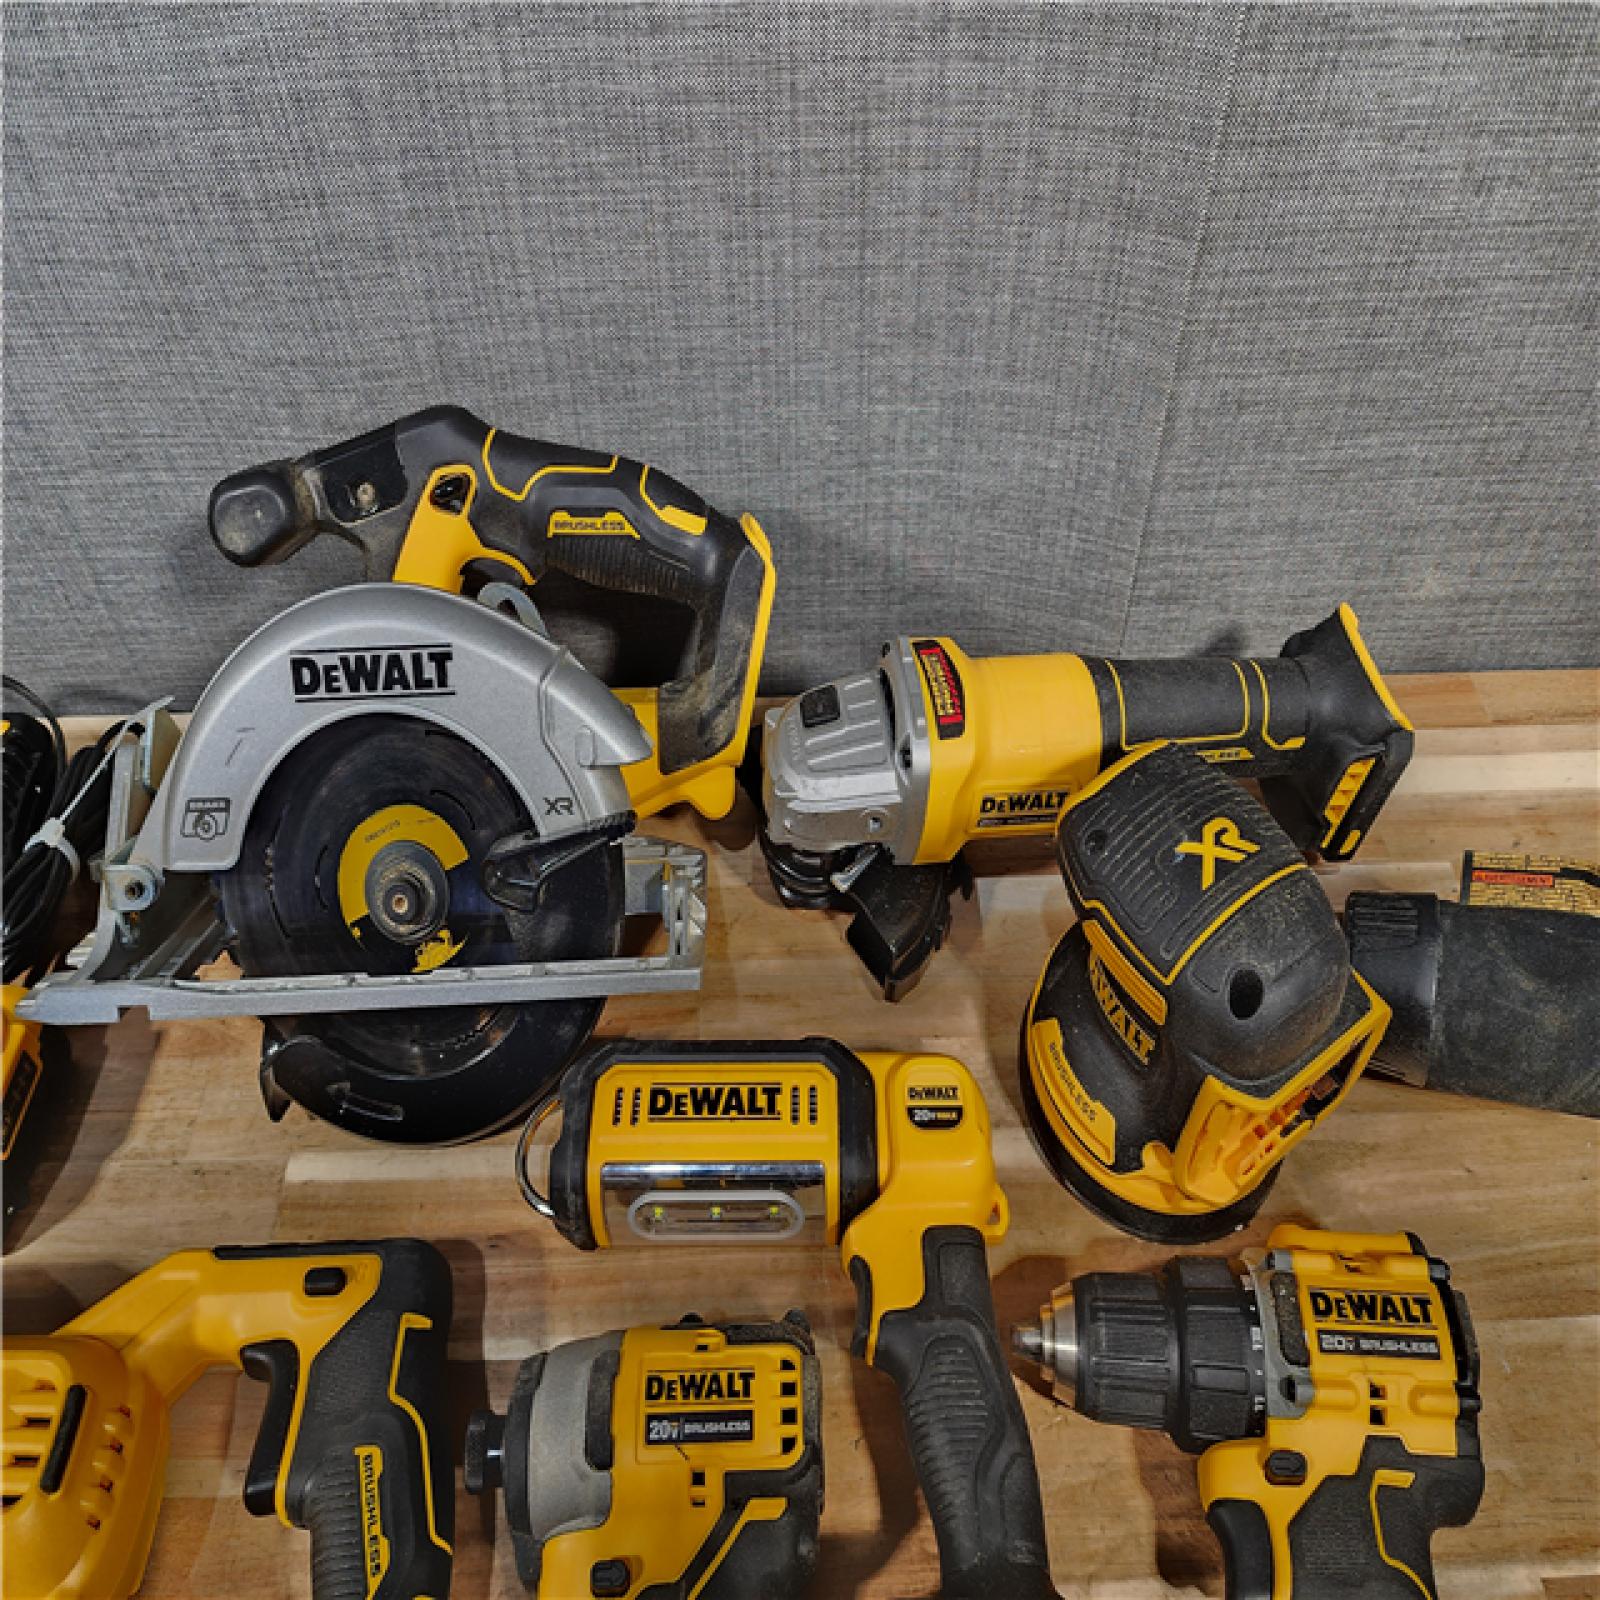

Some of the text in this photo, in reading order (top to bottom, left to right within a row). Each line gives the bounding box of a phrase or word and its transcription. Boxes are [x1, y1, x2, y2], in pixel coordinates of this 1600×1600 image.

[554, 521, 625, 531] BRUSHLESS
[290, 652, 453, 696] DEWALT
[543, 797, 573, 815] XR
[981, 791, 1070, 813] DEWALT
[1175, 817, 1260, 890] XR
[1090, 954, 1156, 1066] WALT
[908, 1087, 958, 1100] DEWALT
[1049, 1041, 1097, 1121] BRUSHLESS
[649, 1087, 782, 1116] DEWALT
[1310, 1291, 1433, 1323] DEWALT
[1360, 1339, 1439, 1353] BRUSHLESS
[645, 1372, 755, 1401] DEWALT
[649, 1419, 751, 1440] 20V BRUSHLESS
[363, 1454, 381, 1577] BRUSHLESS
